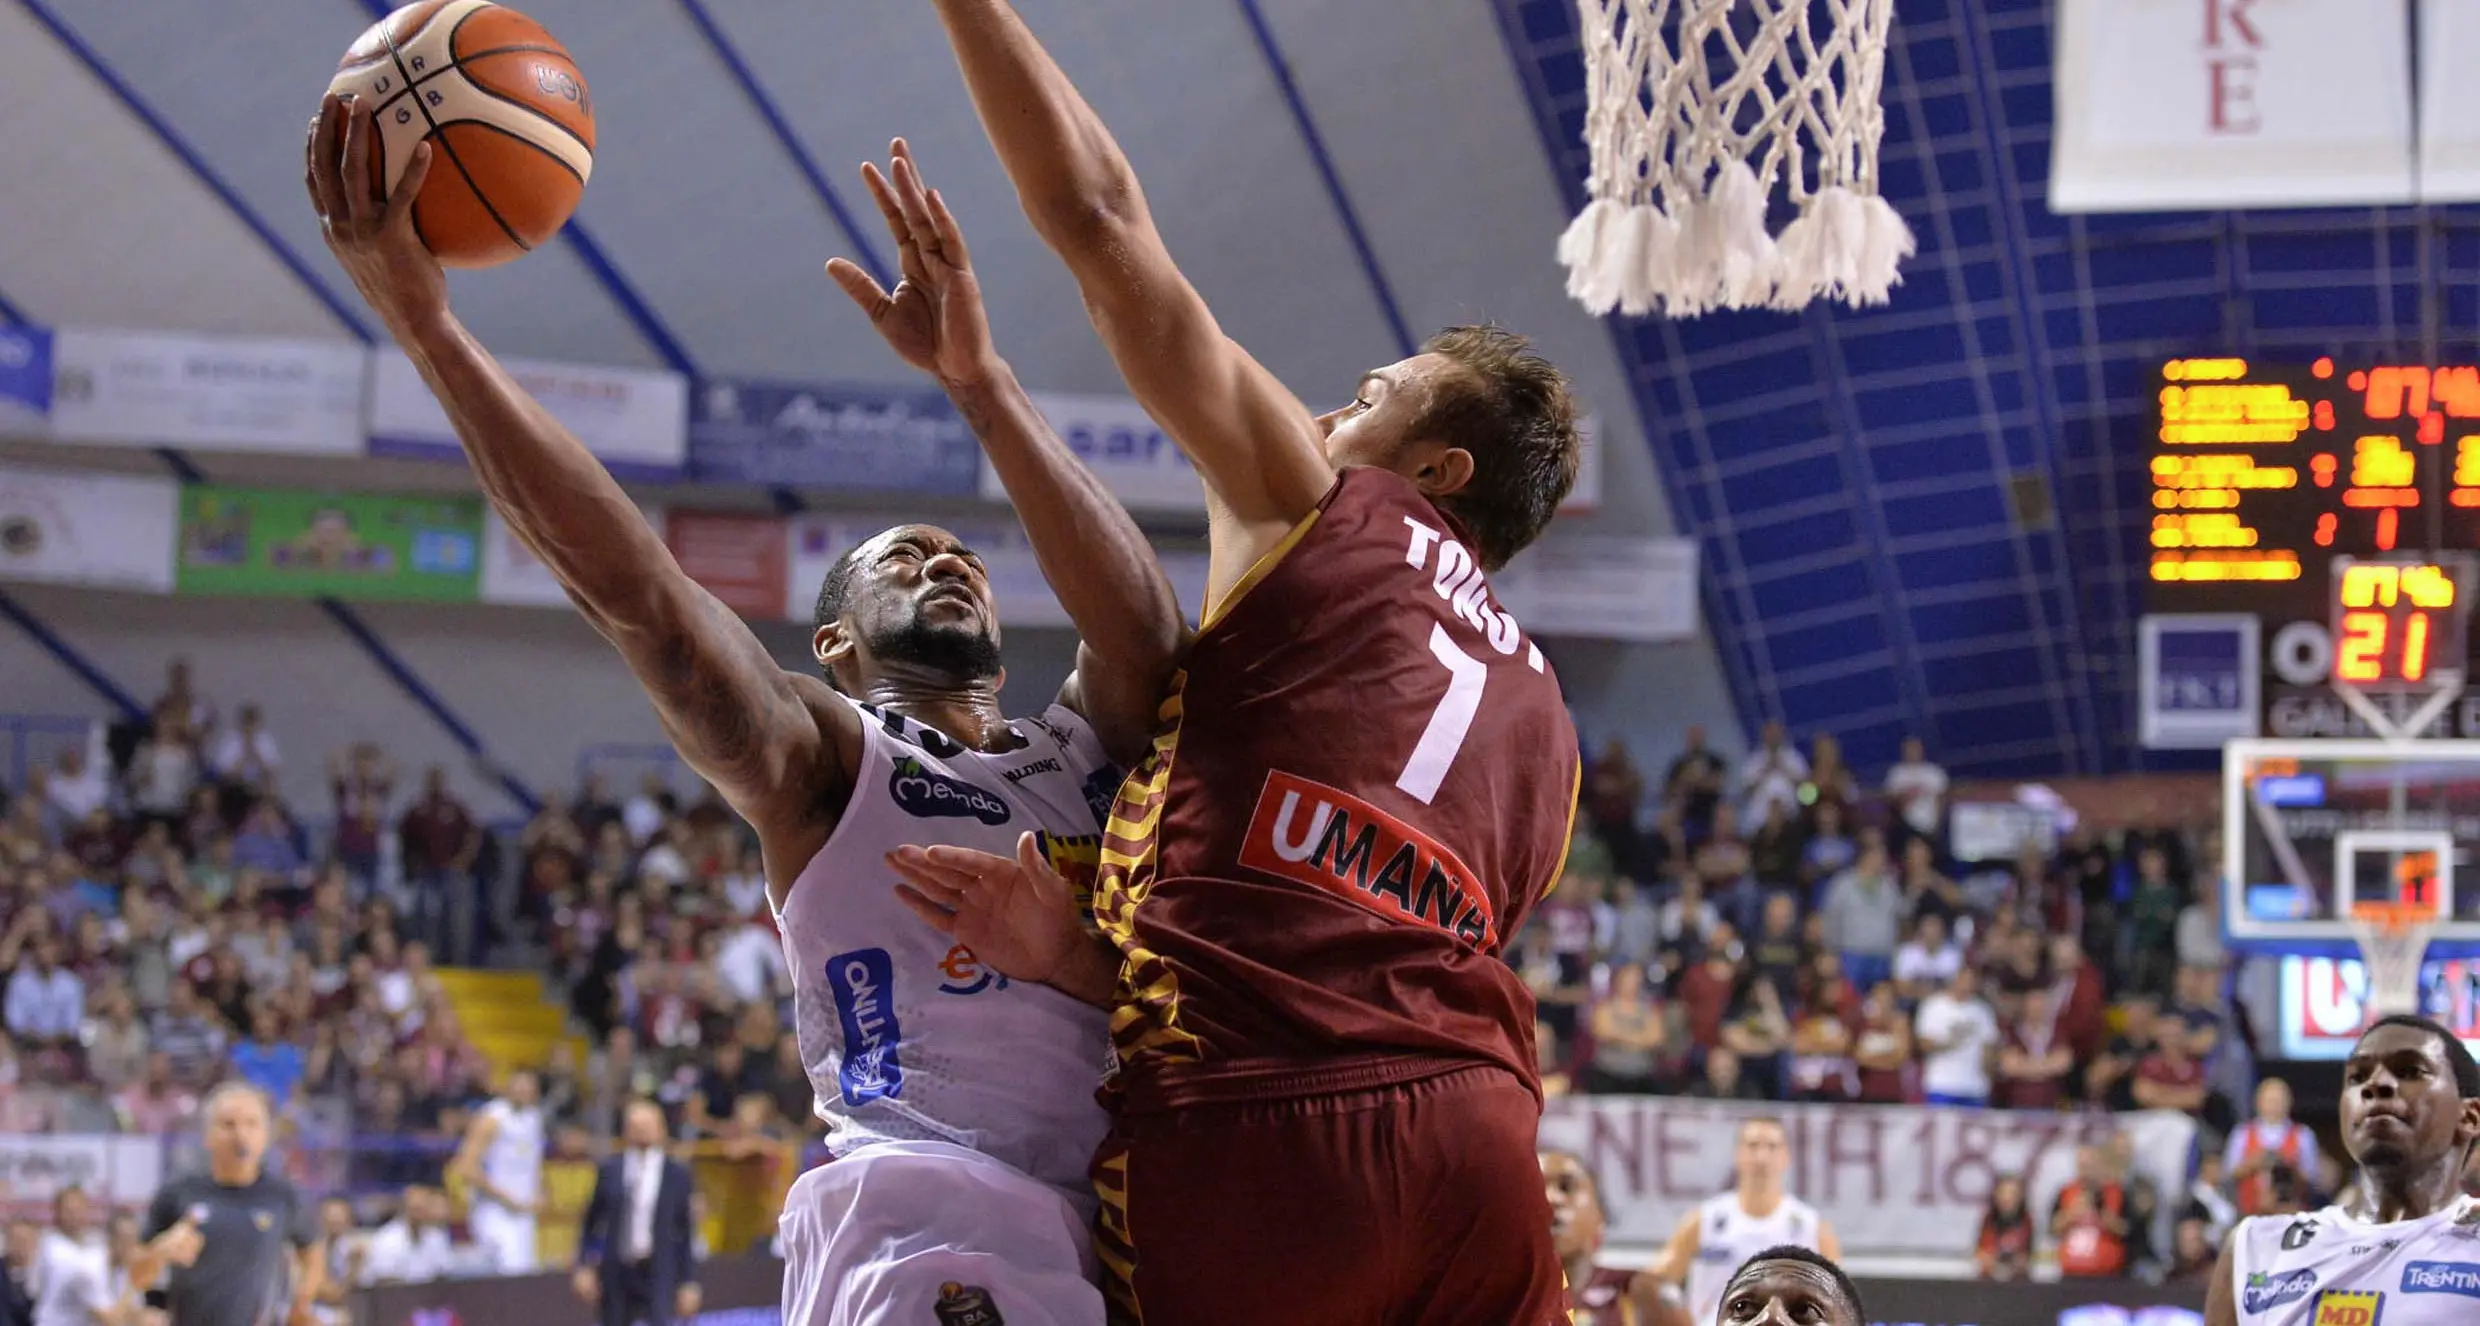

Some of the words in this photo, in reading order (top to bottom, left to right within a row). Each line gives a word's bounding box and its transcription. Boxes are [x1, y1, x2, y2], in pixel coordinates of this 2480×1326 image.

[374, 77, 390, 94] U
[411, 56, 425, 71] R
[395, 107, 411, 124] G
[426, 90, 443, 106] B
[2337, 612, 2428, 681] 21
[1002, 757, 1063, 784] ALDING
